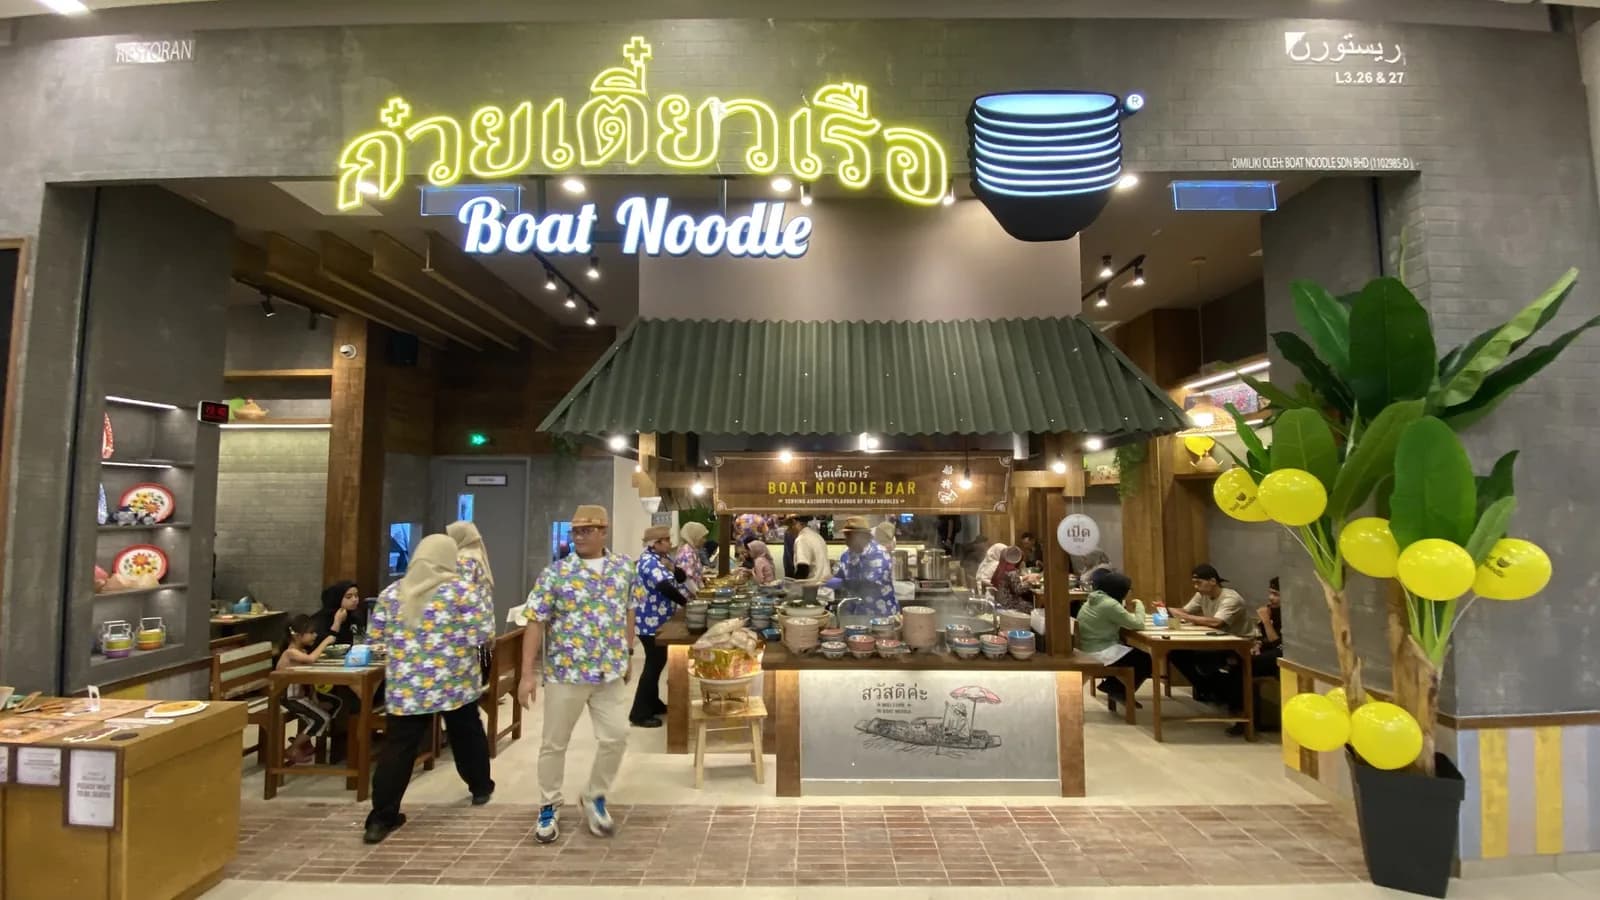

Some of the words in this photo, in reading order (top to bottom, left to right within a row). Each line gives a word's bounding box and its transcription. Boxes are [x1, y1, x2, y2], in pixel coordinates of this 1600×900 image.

[1335, 71, 1374, 84] L3.26
[1376, 71, 1386, 84] &
[1388, 71, 1404, 84] 27
[1232, 157, 1261, 169] DIMILIKI
[1285, 157, 1304, 169] BOAT
[1305, 157, 1336, 169] NOODLE
[1337, 157, 1352, 169] SDN
[1353, 157, 1369, 169] BHD
[458, 196, 598, 255] Boat
[616, 197, 812, 258] Noodle
[768, 481, 807, 495] BOAT
[815, 481, 877, 495] NOODLE
[885, 481, 916, 495] BAR
[862, 682, 928, 700] สวัสดีค่ะ
